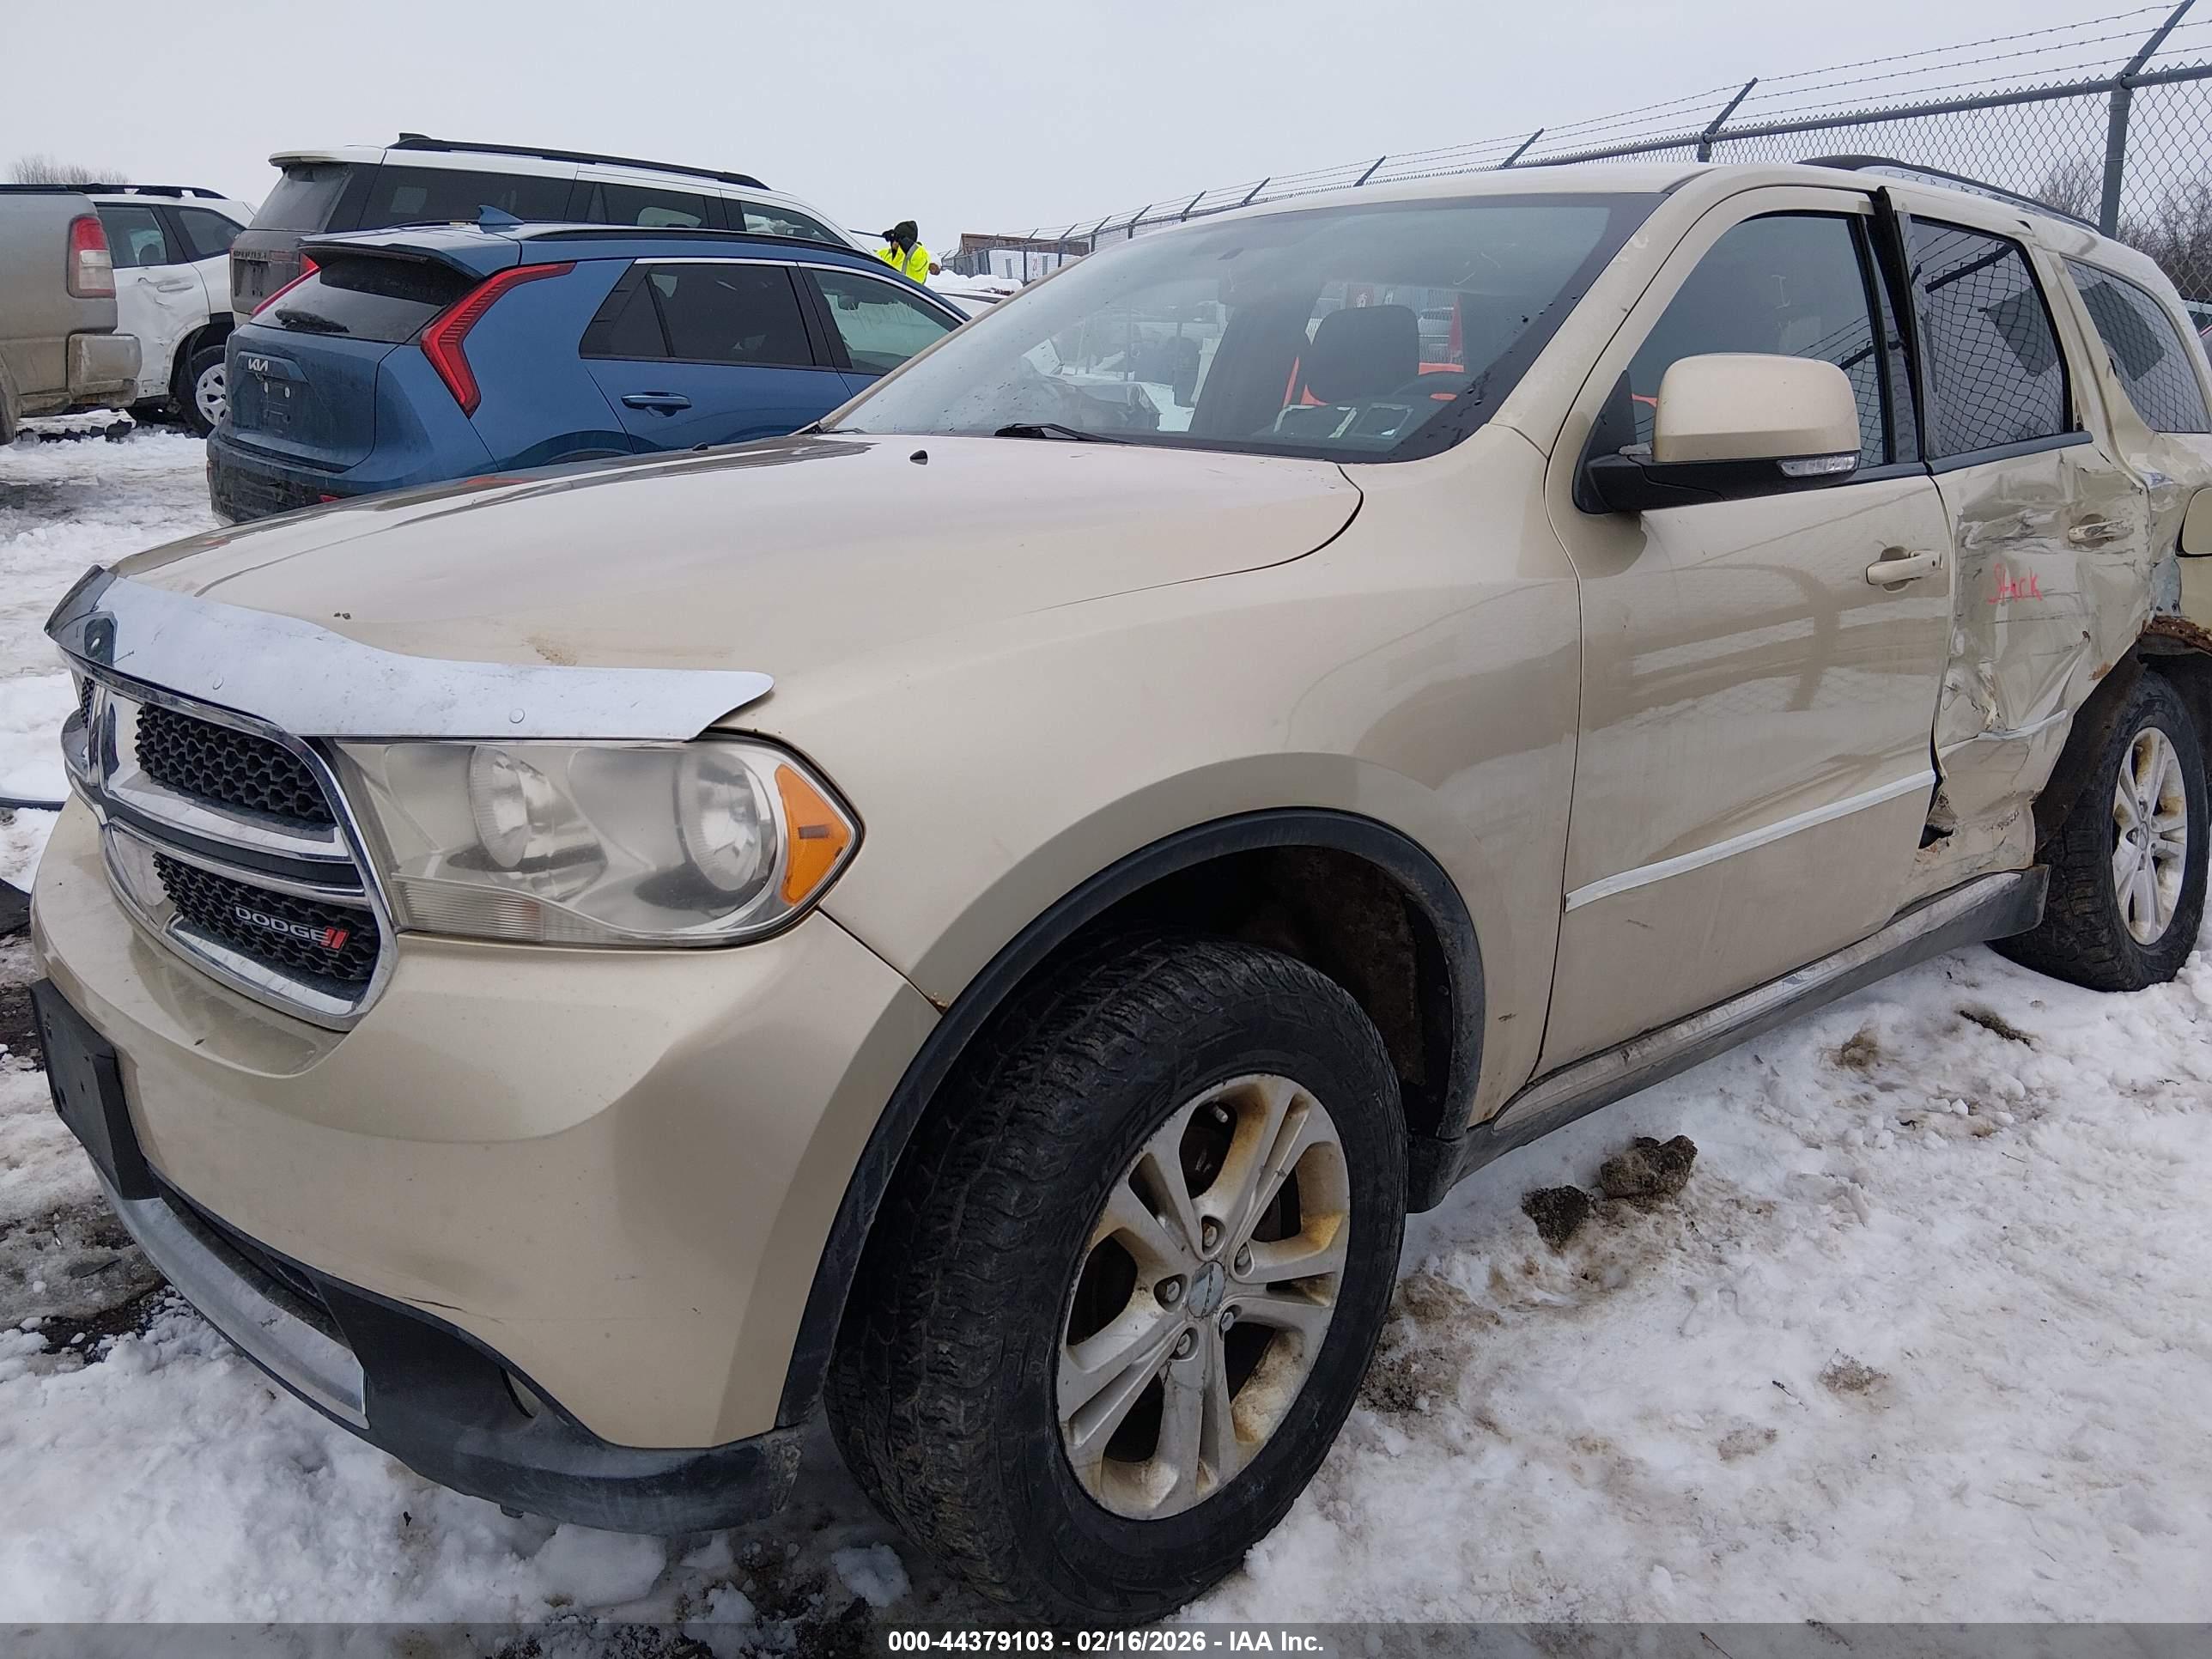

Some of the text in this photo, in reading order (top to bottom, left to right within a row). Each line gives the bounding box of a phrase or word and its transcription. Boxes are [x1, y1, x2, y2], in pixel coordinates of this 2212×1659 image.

[248, 358, 269, 372] KIA
[234, 906, 331, 945] DODGE
[1057, 1059, 1198, 1258] COOPER
